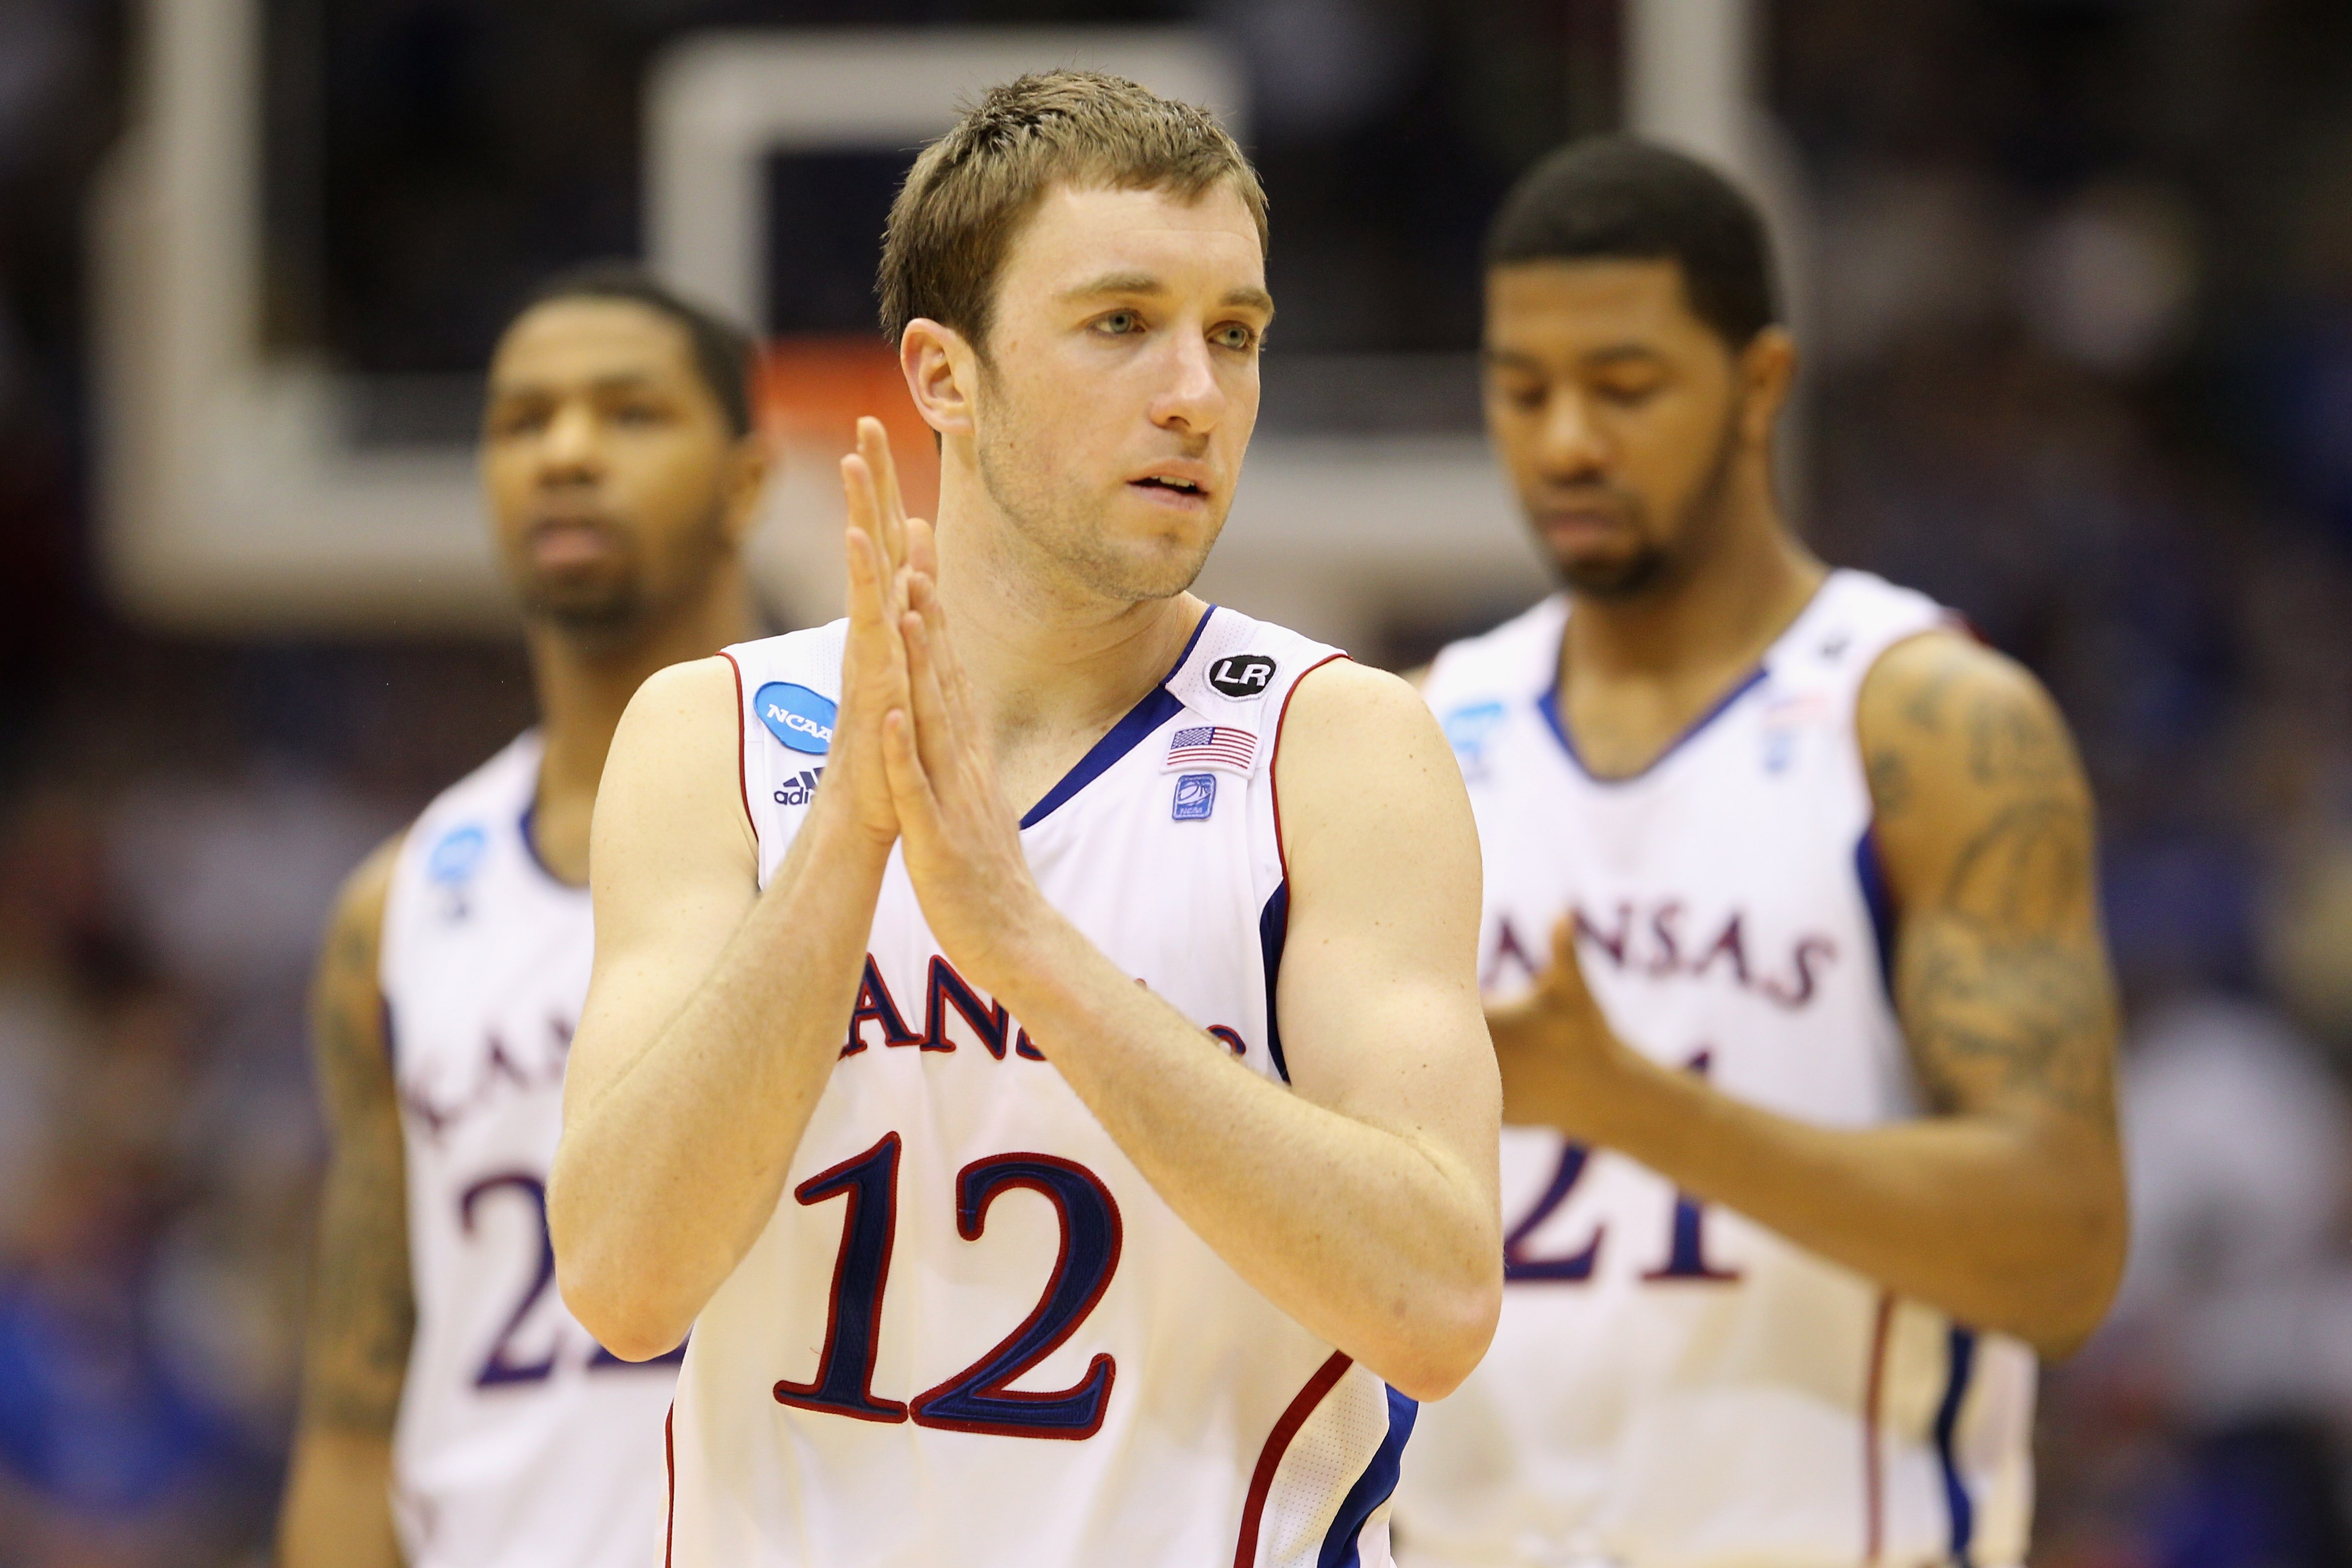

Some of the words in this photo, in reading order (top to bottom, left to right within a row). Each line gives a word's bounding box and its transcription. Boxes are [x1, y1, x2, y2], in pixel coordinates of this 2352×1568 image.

[1215, 660, 1271, 686] LR
[767, 703, 833, 743] NCAA
[773, 786, 817, 806] adi
[1477, 898, 1838, 1011] ANSAS
[773, 1130, 1123, 1441] 12
